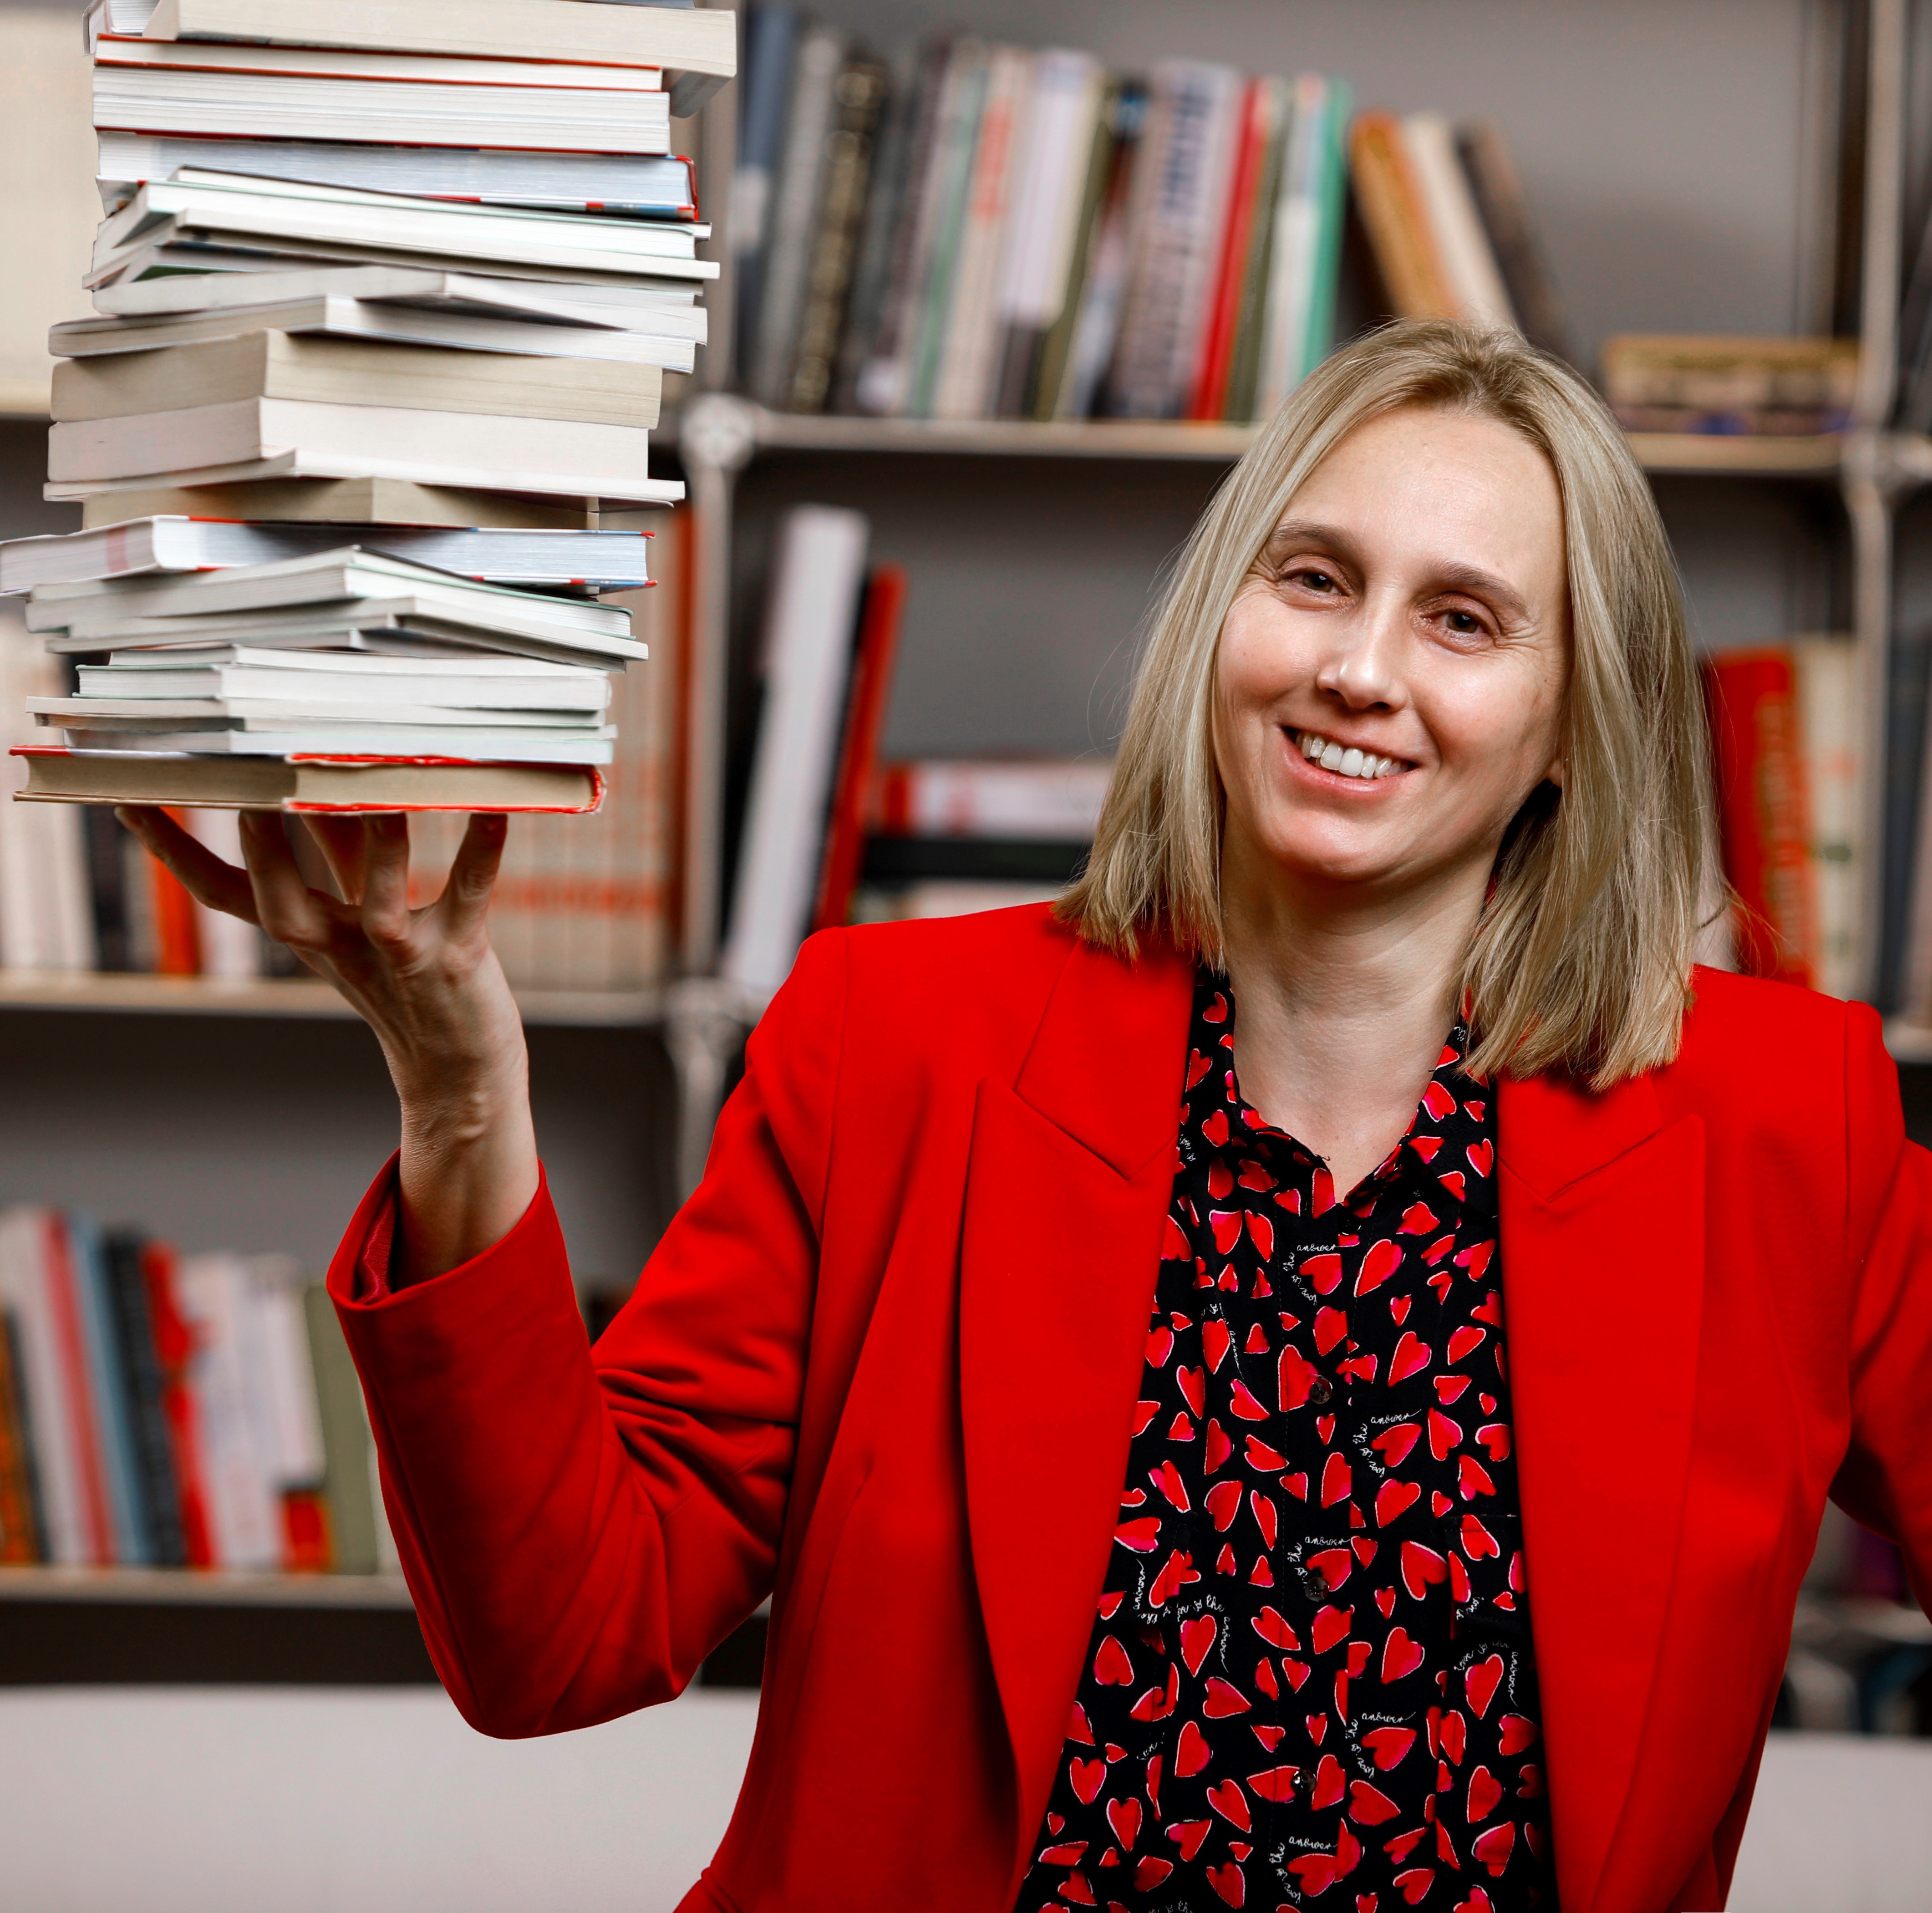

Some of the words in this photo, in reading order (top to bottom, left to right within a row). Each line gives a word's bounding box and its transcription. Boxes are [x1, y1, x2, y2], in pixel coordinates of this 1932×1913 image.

[1296, 1243, 1338, 1252] answer
[1283, 1252, 1295, 1272] the
[1299, 1287, 1317, 1306] love
[1370, 1409, 1423, 1425] answer
[1352, 1423, 1368, 1445] the
[1359, 1448, 1373, 1460] is
[1368, 1461, 1385, 1478] love
[1287, 1542, 1302, 1562] the
[1305, 1537, 1351, 1546] answer
[1206, 1594, 1225, 1612] the
[1220, 1617, 1230, 1673] answer
[1508, 1651, 1520, 1707] answer
[1361, 1711, 1416, 1724] answer
[1345, 1719, 1359, 1740] the
[1357, 1757, 1375, 1779] love
[1269, 1842, 1286, 1864] the
[1288, 1836, 1339, 1850] answer
[1283, 1882, 1302, 1904] love
